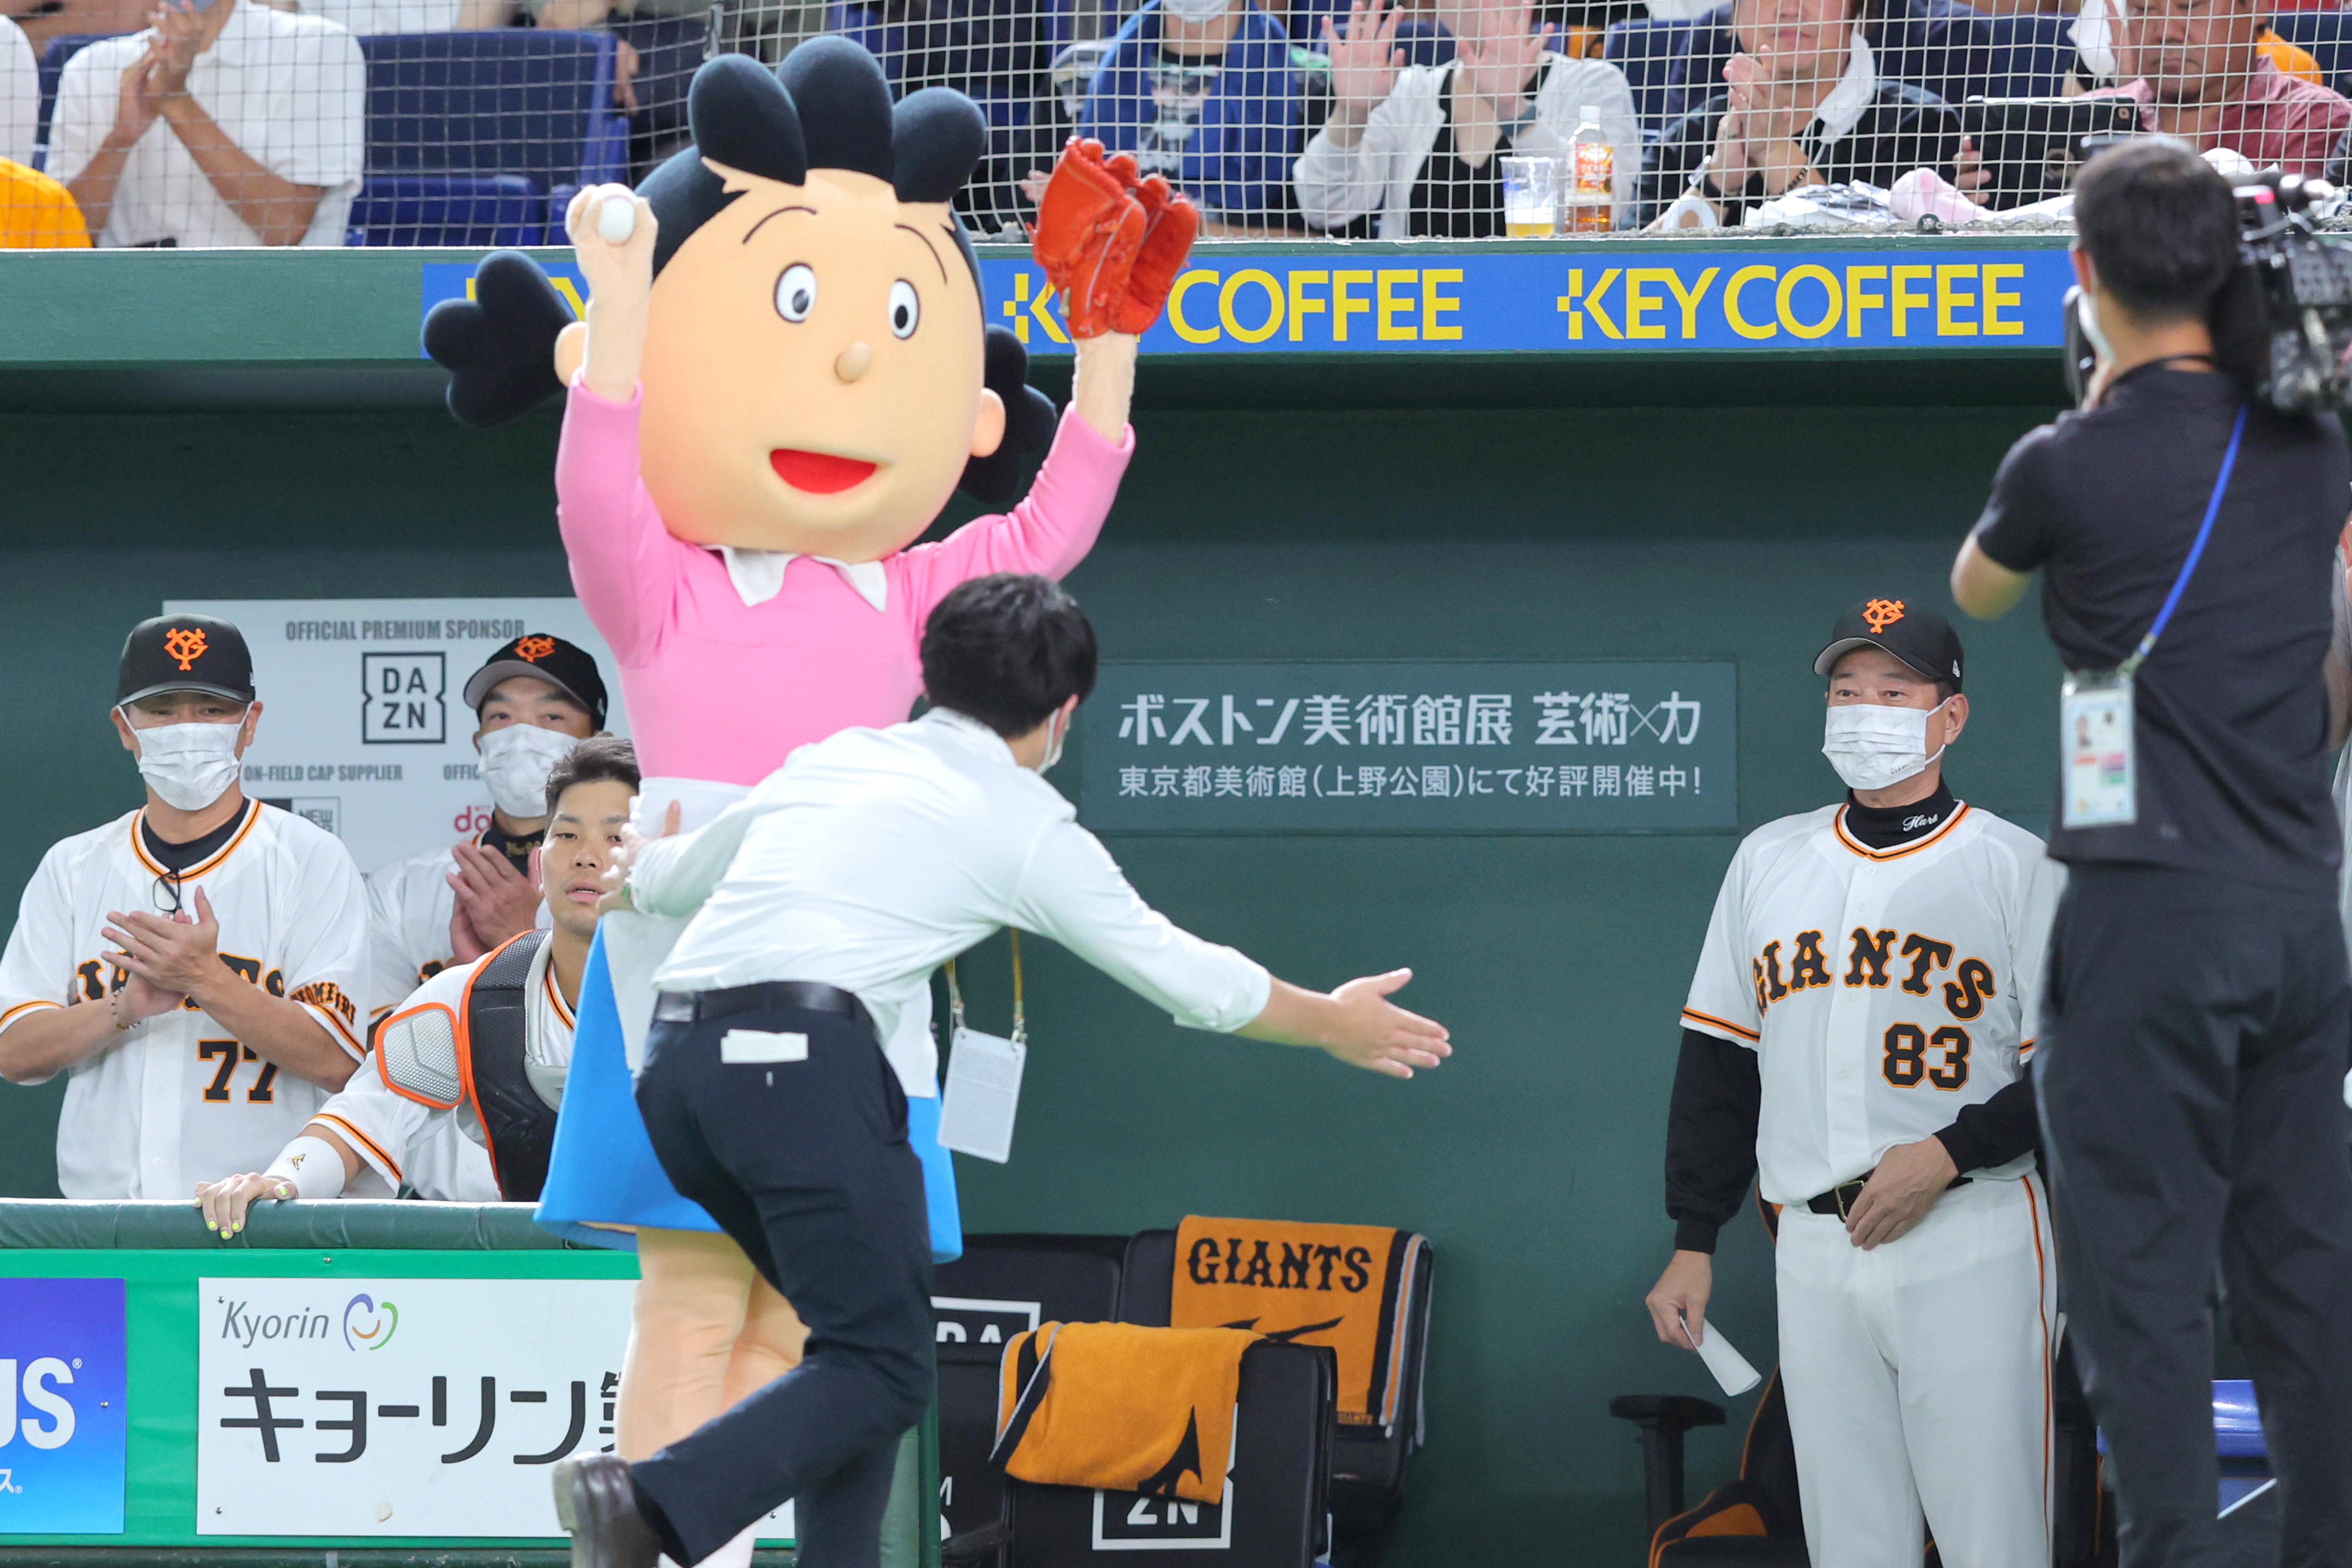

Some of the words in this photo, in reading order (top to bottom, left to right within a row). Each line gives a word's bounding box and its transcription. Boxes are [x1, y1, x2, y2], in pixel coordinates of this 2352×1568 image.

[286, 621, 357, 641] OFFICIAL
[362, 621, 441, 640] PREMIUM
[446, 620, 525, 639] SPONSOR
[1118, 694, 1512, 745] ボストン美術館展
[244, 765, 303, 781] ON-FIELD
[308, 765, 334, 781] CAP
[338, 765, 403, 781] SUPPLIER
[444, 764, 480, 780] OFFIC
[197, 1039, 278, 1103] 77
[1883, 1022, 1971, 1091] 83
[1187, 1238, 1371, 1293] GIANTS
[222, 1301, 329, 1348] Kyorin
